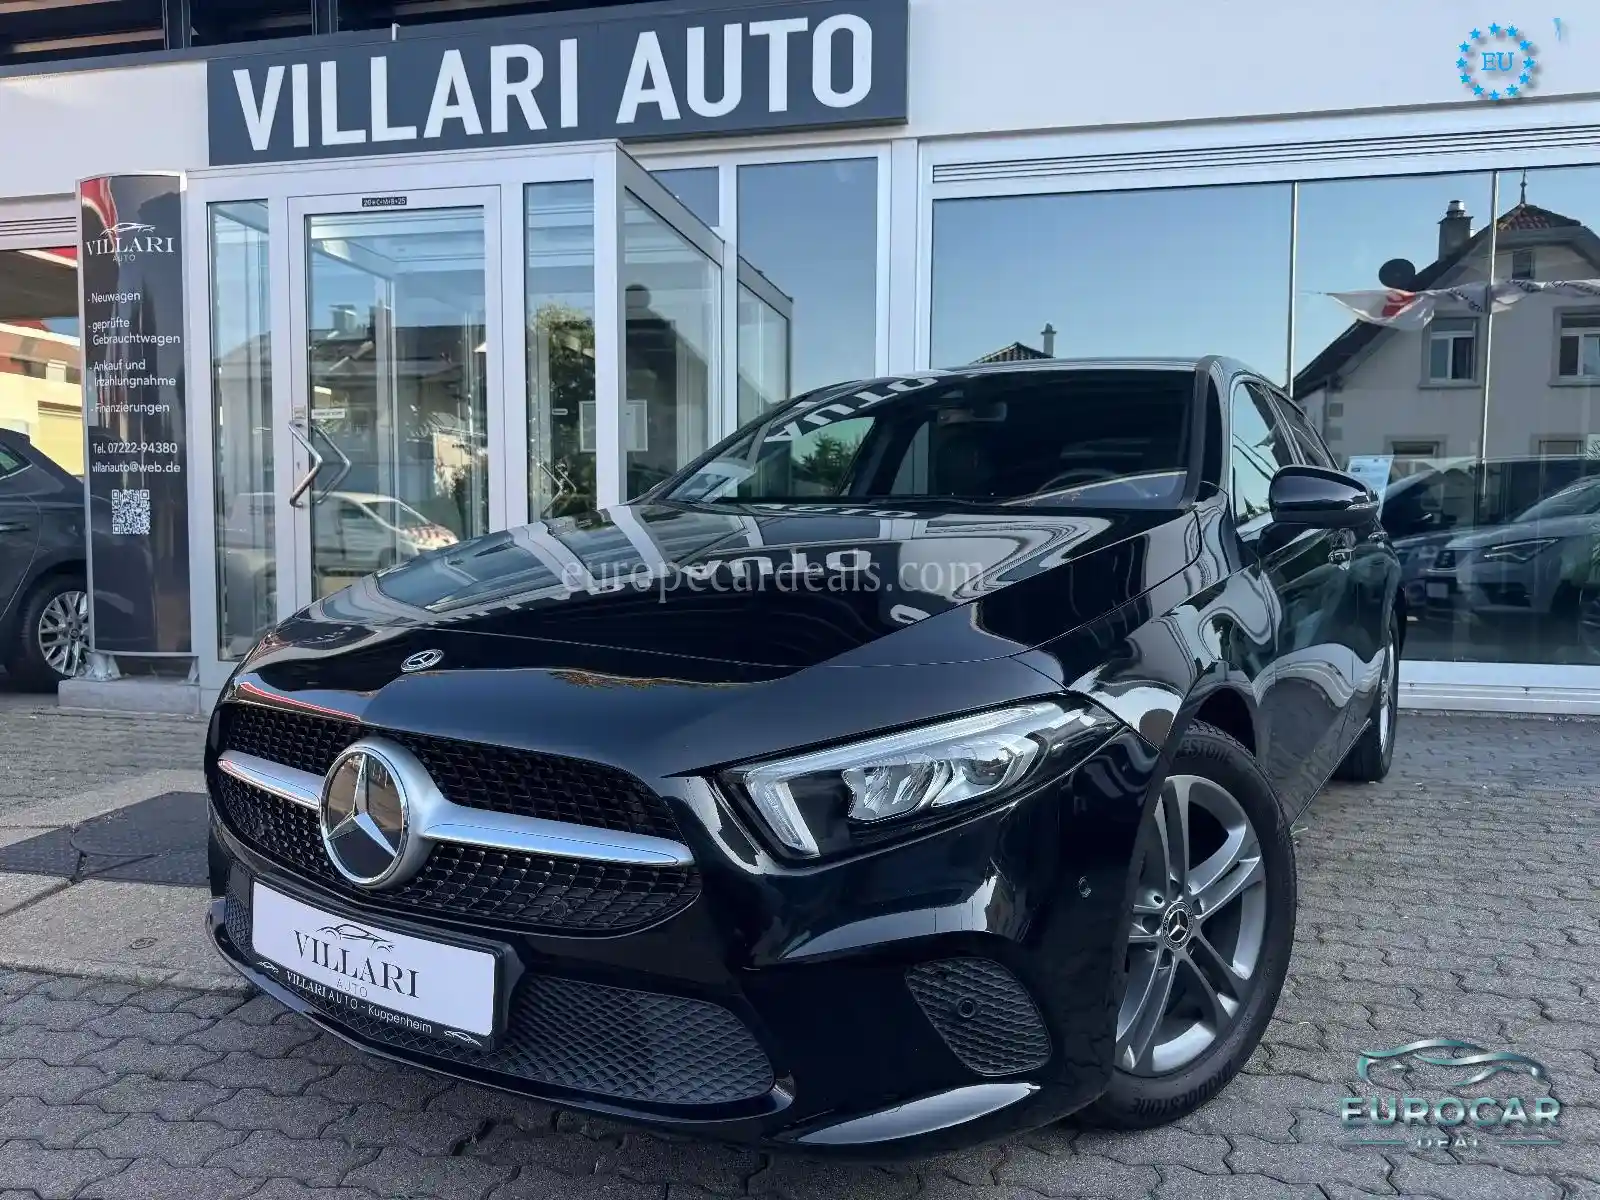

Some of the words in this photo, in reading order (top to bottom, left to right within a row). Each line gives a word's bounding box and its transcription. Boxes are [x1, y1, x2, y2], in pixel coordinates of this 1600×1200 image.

[233, 38, 578, 151] VILLARI
[615, 13, 872, 124] AUTO
[85, 236, 175, 256] VILLARI
[112, 254, 136, 262] AUTO
[91, 292, 141, 303] Neuwagen
[92, 317, 130, 332] geprüfte
[92, 332, 181, 346] Gebrauchtwagen
[93, 359, 122, 371] Ankauf
[125, 359, 146, 370] und
[94, 374, 177, 388] Inzahlungnahme
[95, 402, 170, 415] Finanzierungen
[93, 443, 106, 454] Tel.
[108, 442, 178, 454] 07222-94380
[92, 461, 181, 473] villariauto@web.de
[293, 929, 420, 999] VILLARI
[336, 977, 369, 998] AUTO
[286, 970, 327, 998] VILLARI
[328, 990, 358, 1010] AUTO
[367, 1004, 432, 1034] Kuppenheim
